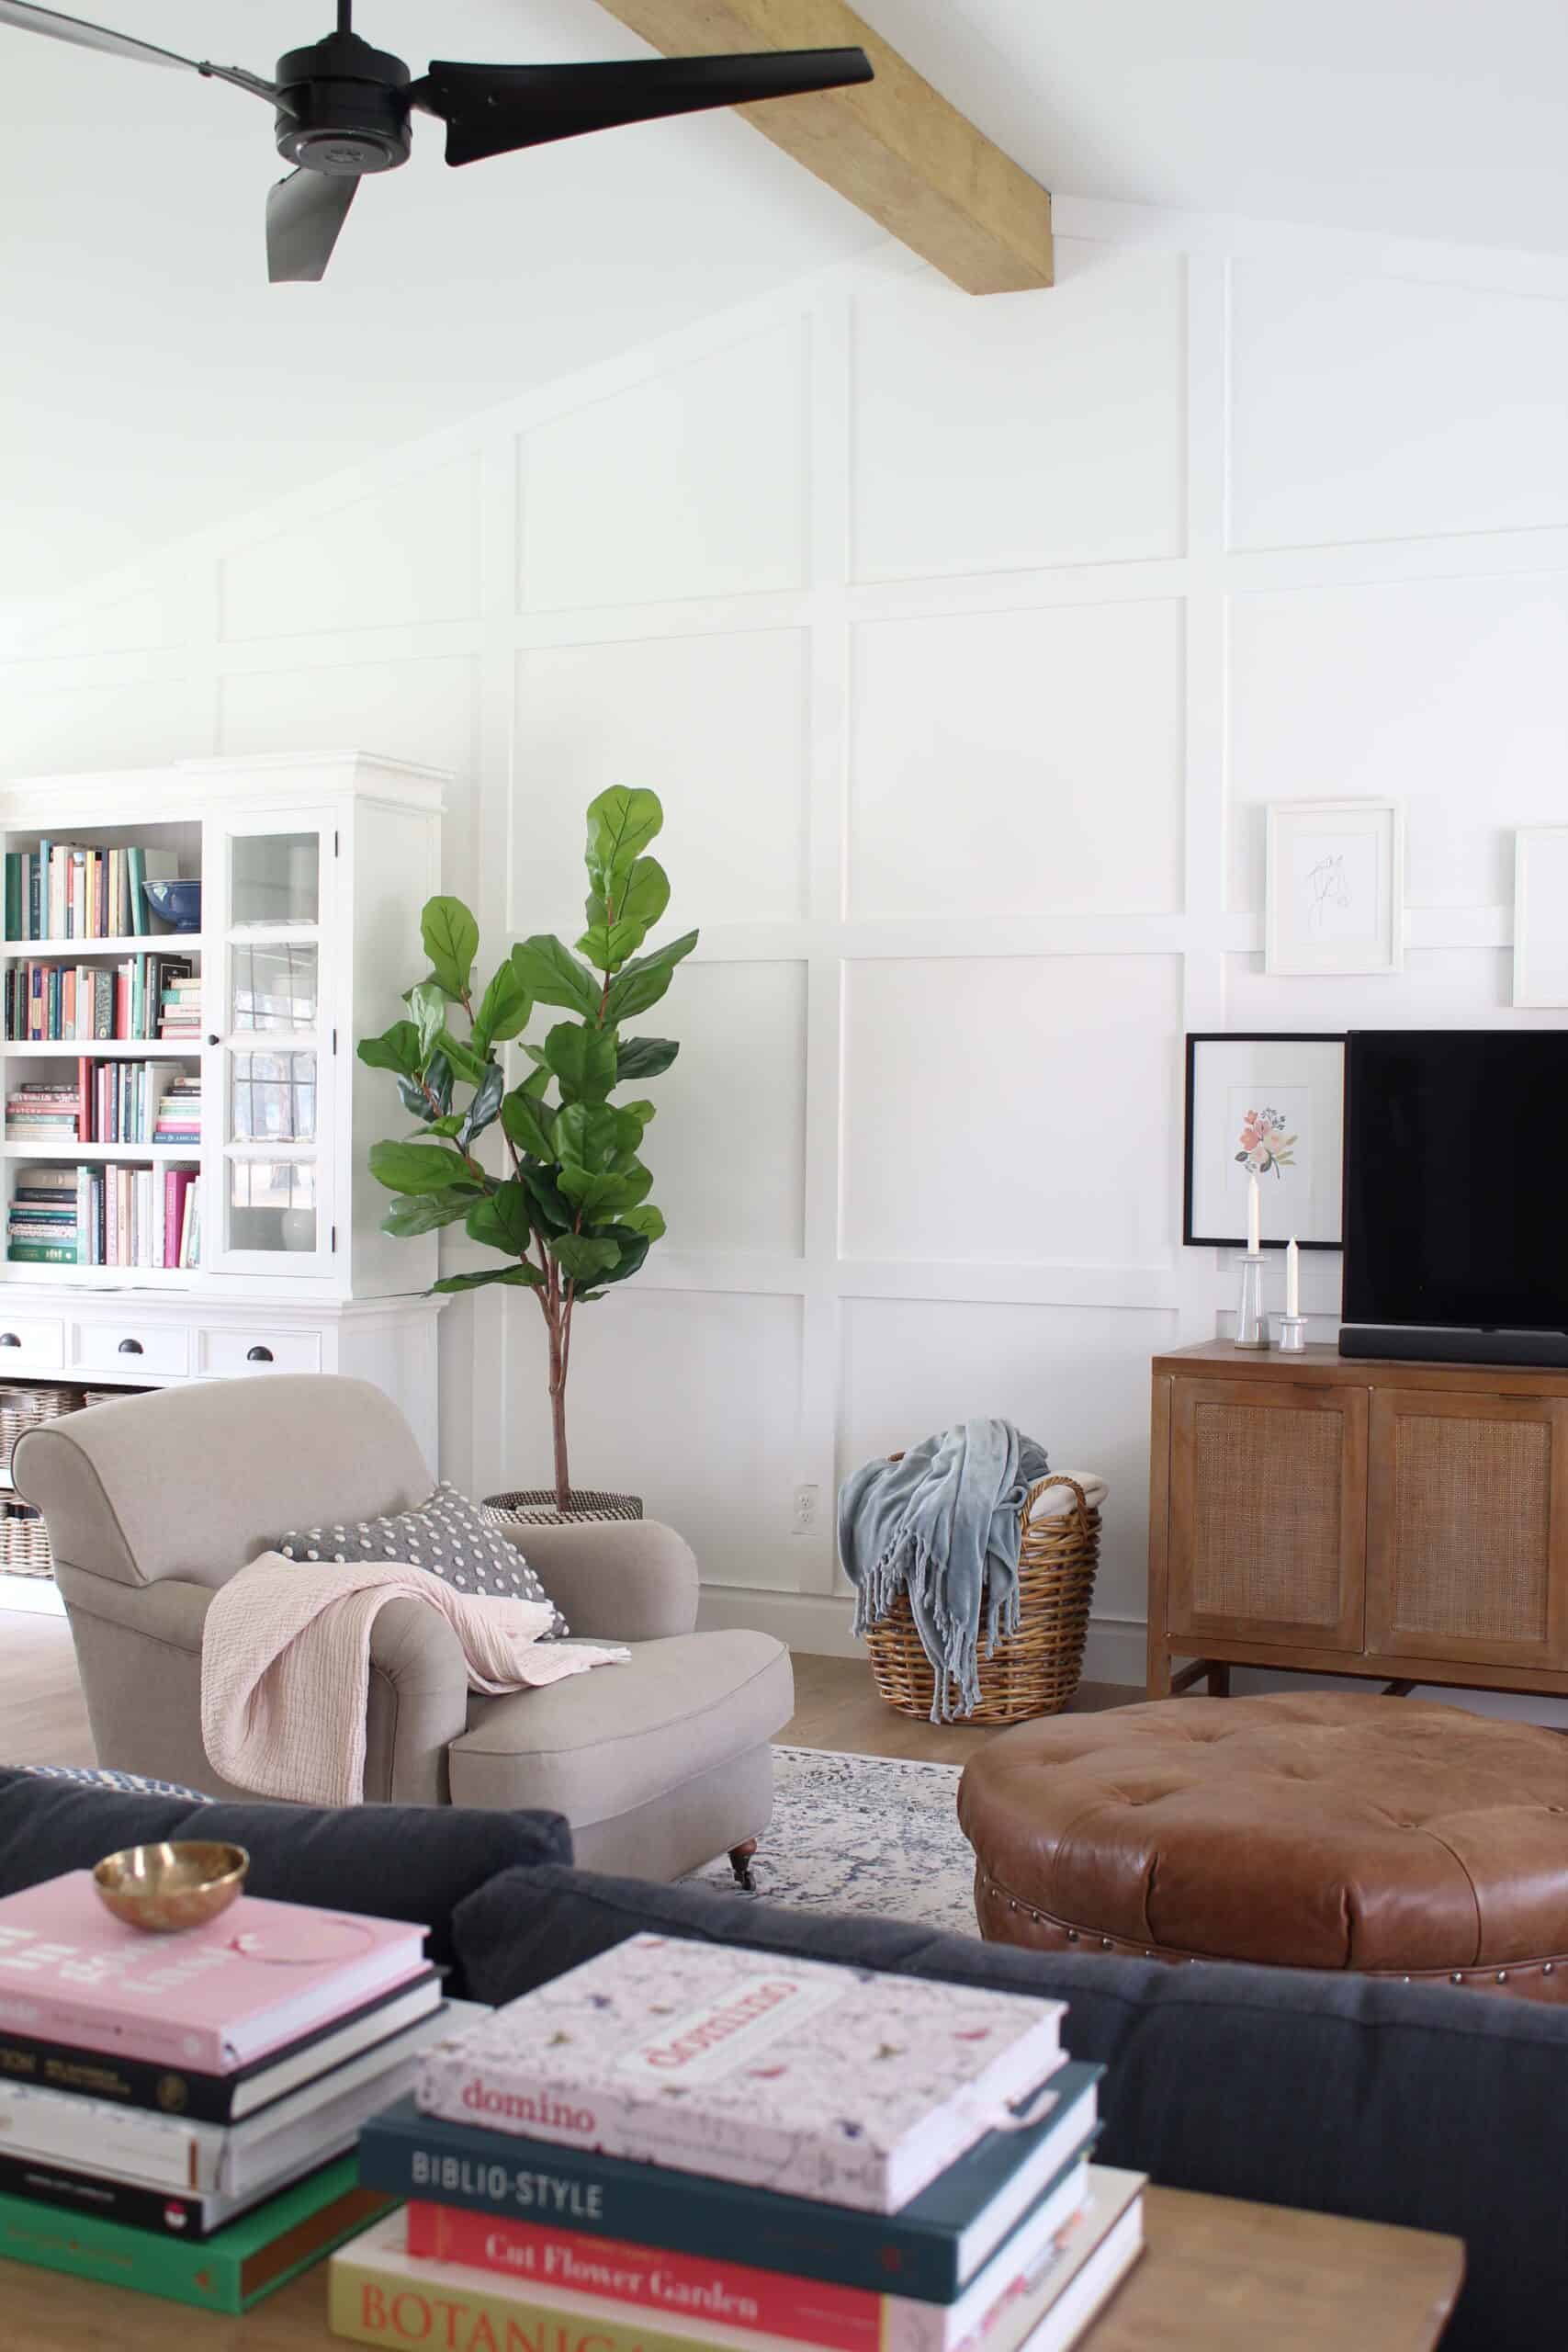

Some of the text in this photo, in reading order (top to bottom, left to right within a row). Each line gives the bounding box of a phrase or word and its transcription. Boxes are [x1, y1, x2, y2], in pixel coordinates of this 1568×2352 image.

[640, 1982, 798, 2069] domino
[462, 2077, 597, 2132] domino
[412, 2151, 604, 2221] BIBLIO-STYLE
[485, 2233, 535, 2269] Cut
[544, 2244, 643, 2293] Flower
[649, 2269, 758, 2320] Garden
